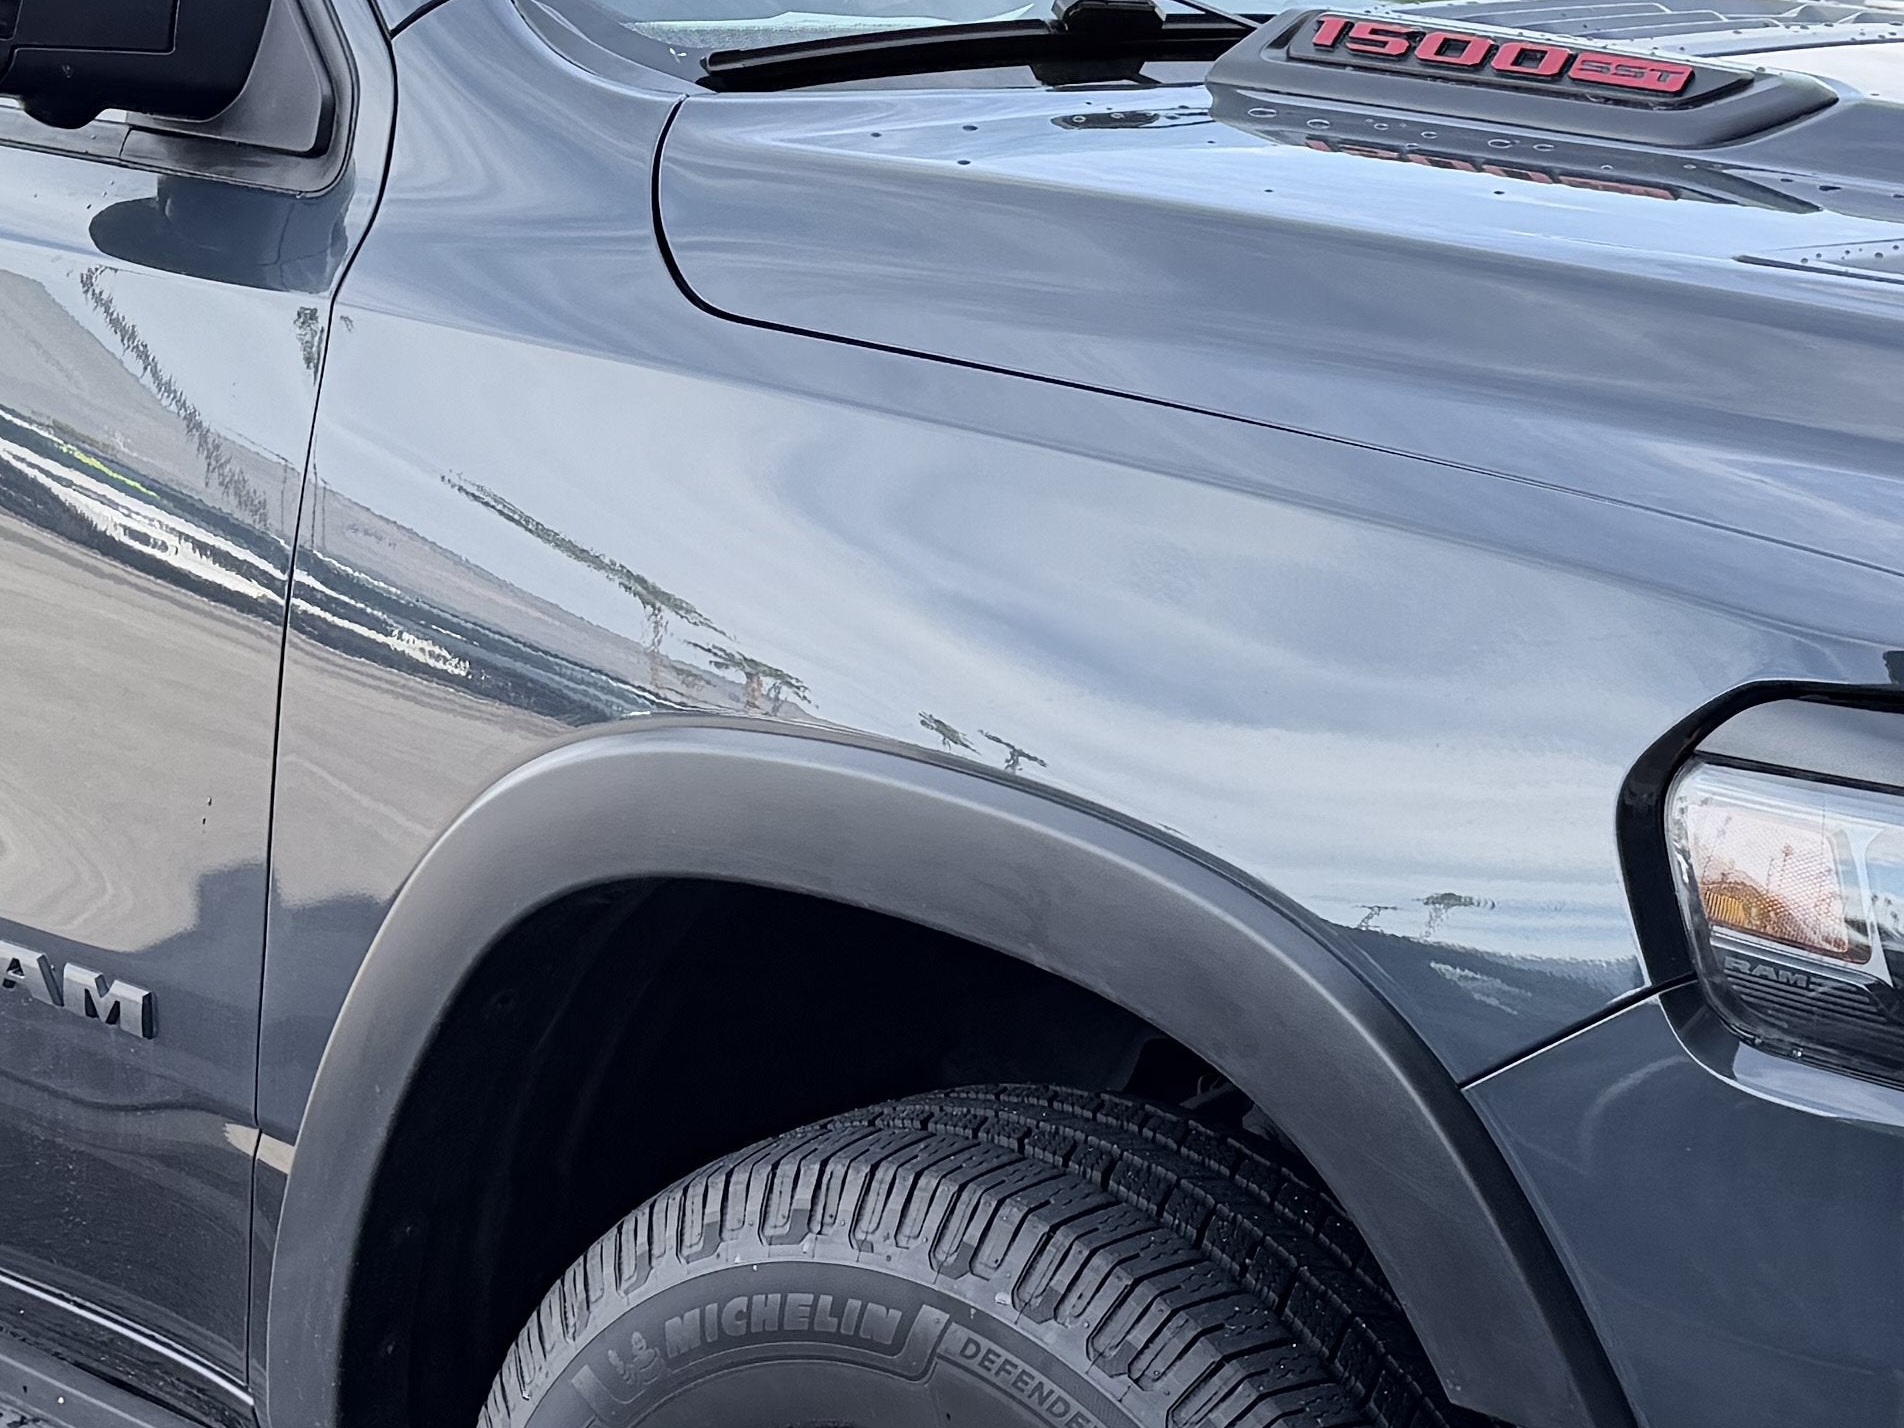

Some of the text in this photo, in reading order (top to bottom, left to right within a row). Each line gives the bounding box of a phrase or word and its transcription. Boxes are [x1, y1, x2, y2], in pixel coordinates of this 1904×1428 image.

[1311, 12, 1574, 79] 1500
[1724, 956, 1808, 987] RAM
[665, 1292, 903, 1359] MICHELIN
